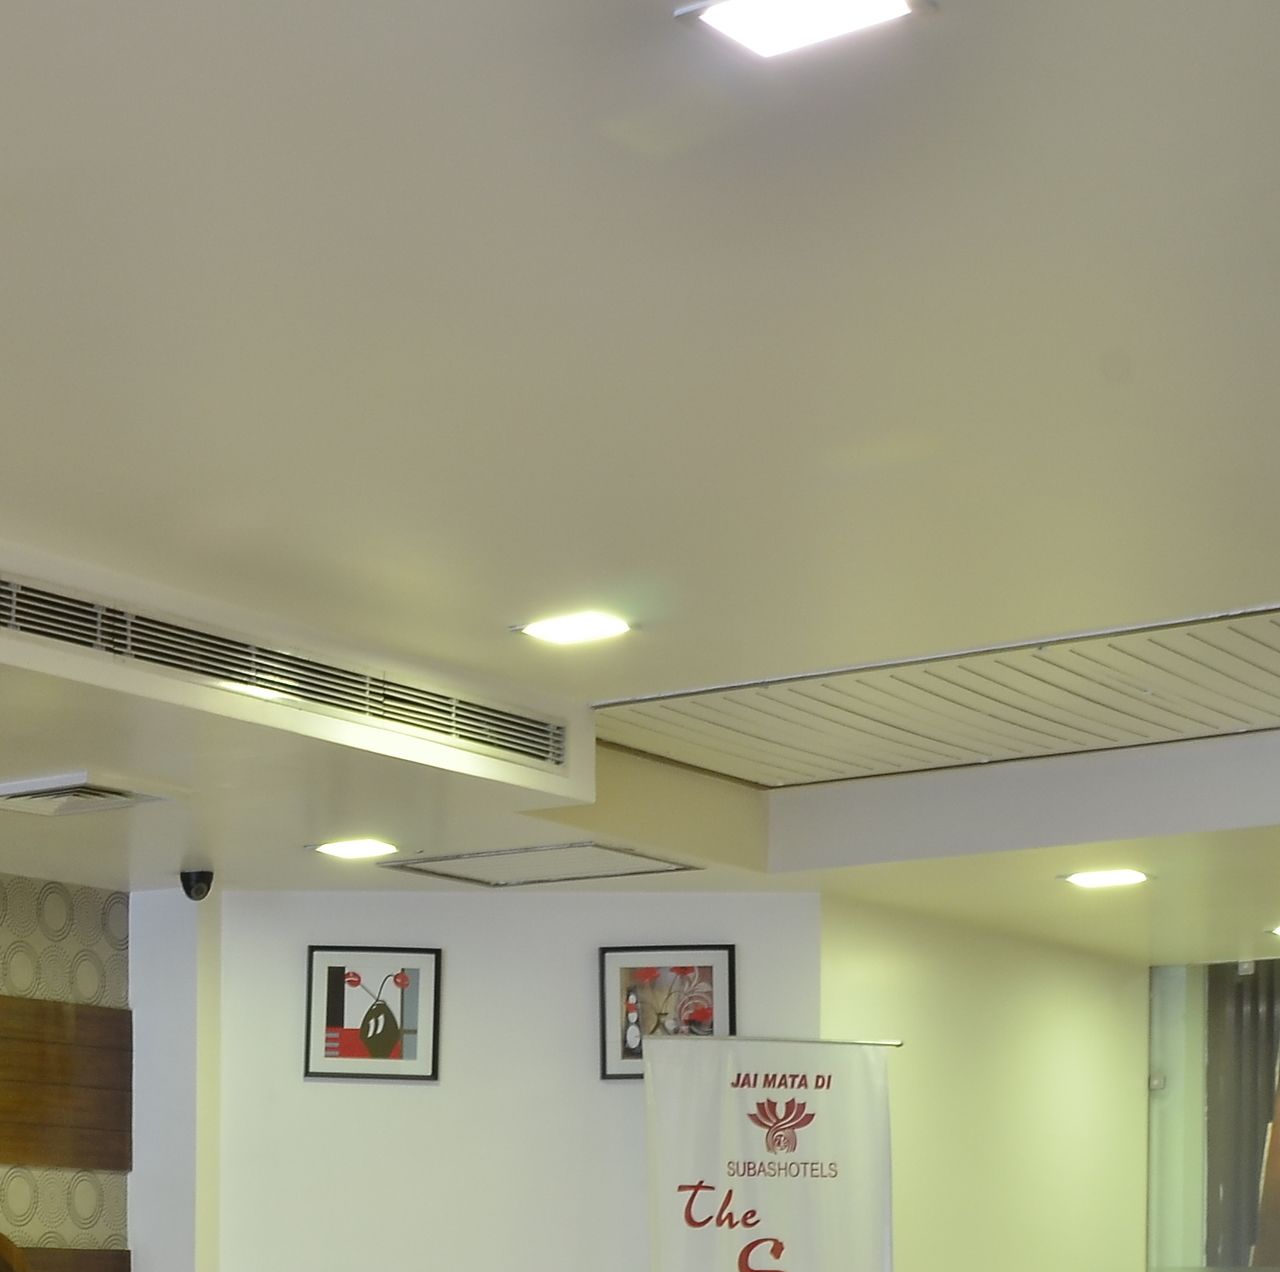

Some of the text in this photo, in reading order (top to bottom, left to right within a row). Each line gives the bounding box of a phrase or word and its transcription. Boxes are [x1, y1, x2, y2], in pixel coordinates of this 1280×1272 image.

[731, 1073, 832, 1090] JAI MATA DI
[727, 1161, 838, 1178] SUBASHOTELS
